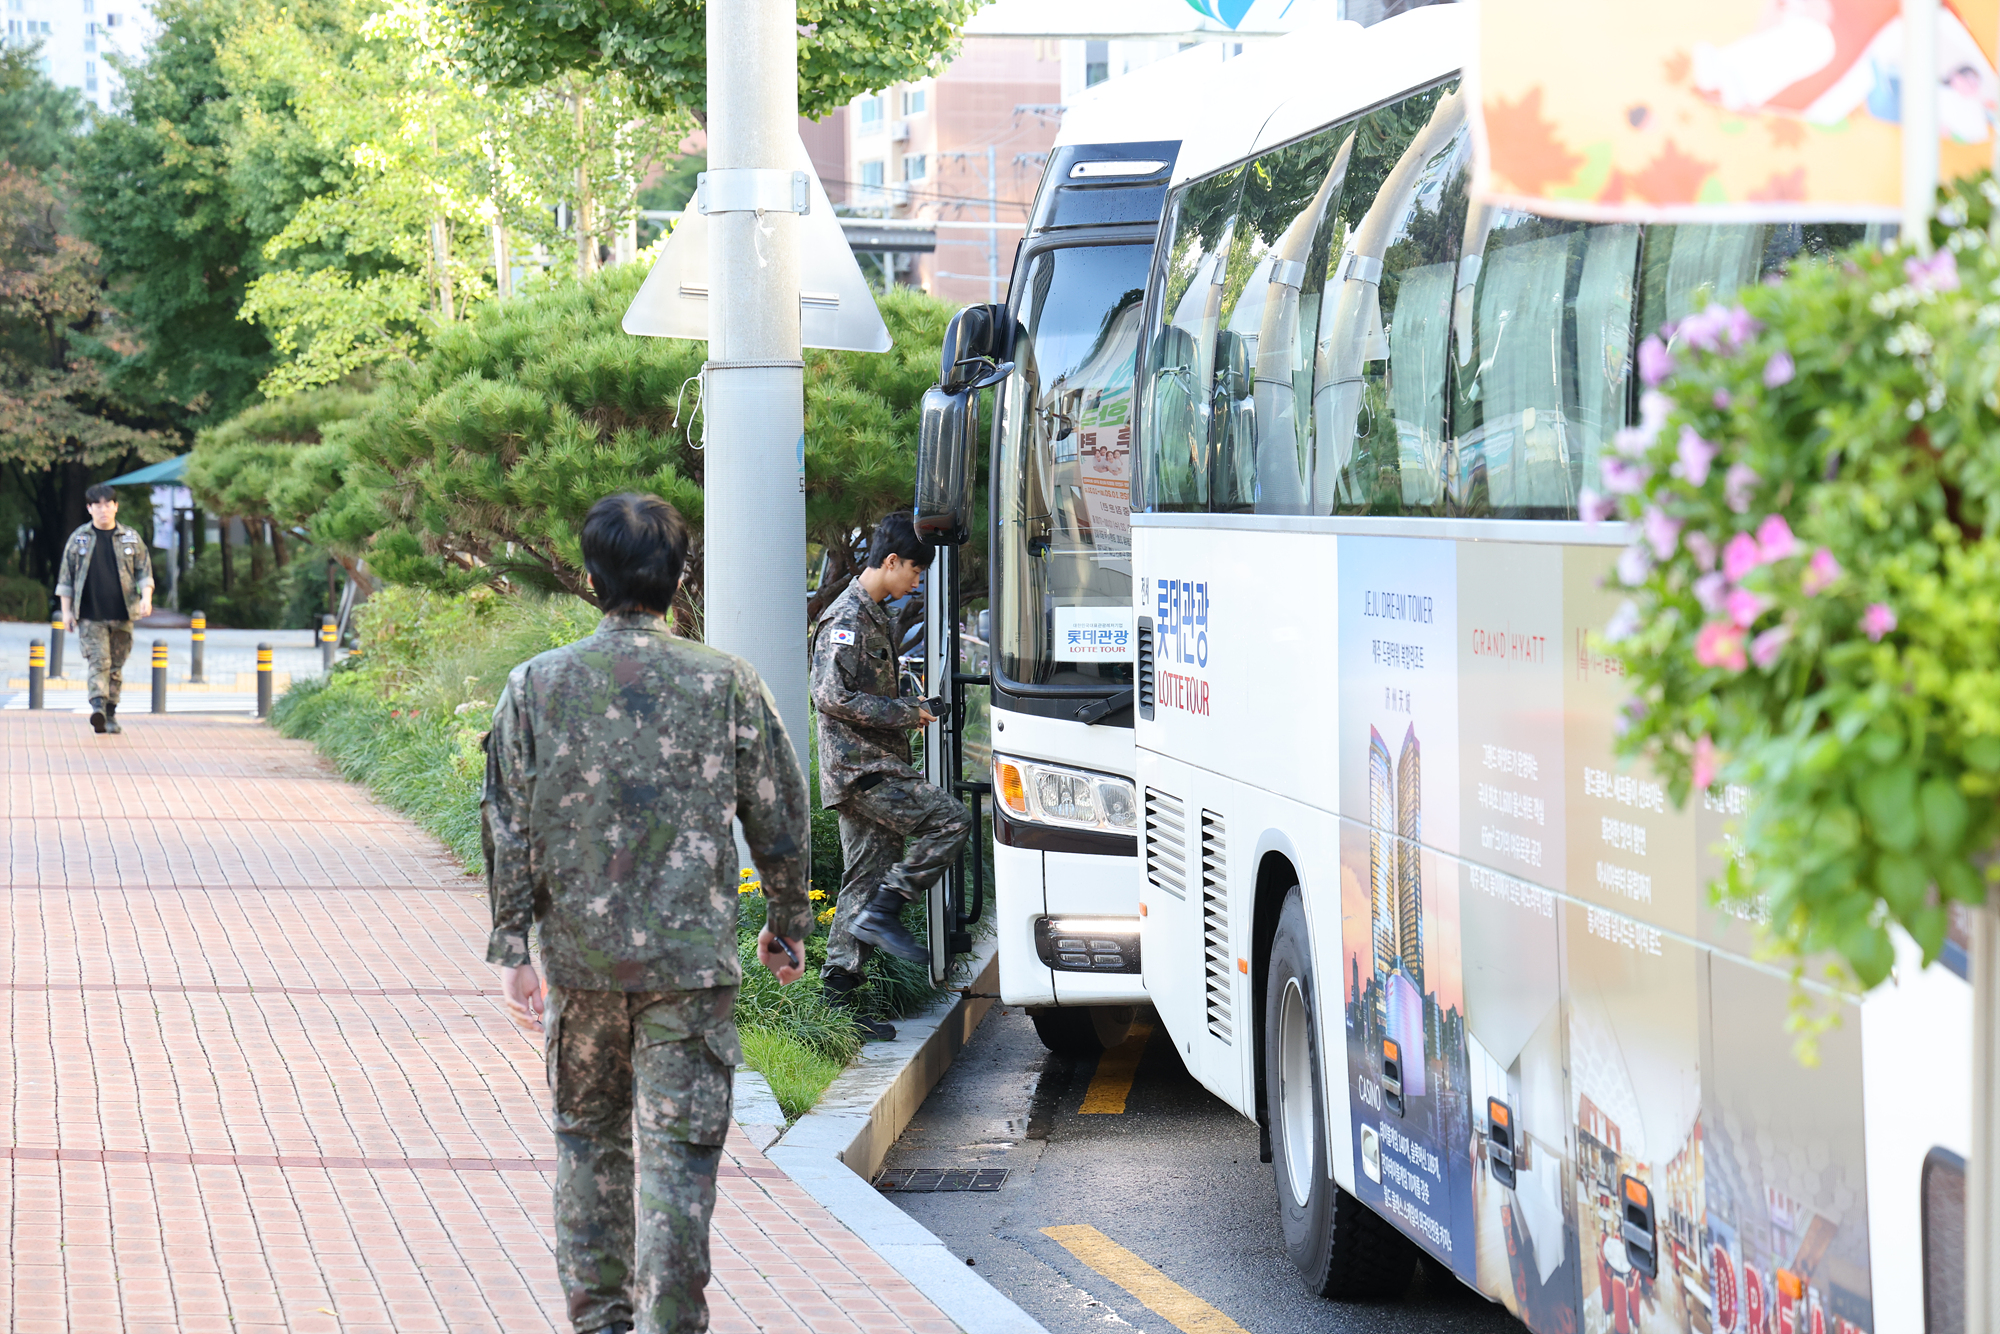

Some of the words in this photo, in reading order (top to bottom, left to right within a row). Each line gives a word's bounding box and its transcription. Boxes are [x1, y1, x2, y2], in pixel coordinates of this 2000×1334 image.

[1157, 578, 1210, 668] 롯데관광
[1363, 590, 1380, 617] JEJU
[1382, 592, 1406, 620] DREAM
[1408, 595, 1433, 624] TOWER
[1067, 629, 1129, 645] 롯데관광
[1473, 629, 1506, 659] GRAND
[1512, 633, 1546, 664] HYATT
[1158, 670, 1184, 710] LOTTE
[1185, 676, 1210, 717] TOUR
[1359, 1074, 1381, 1112] CASINO
